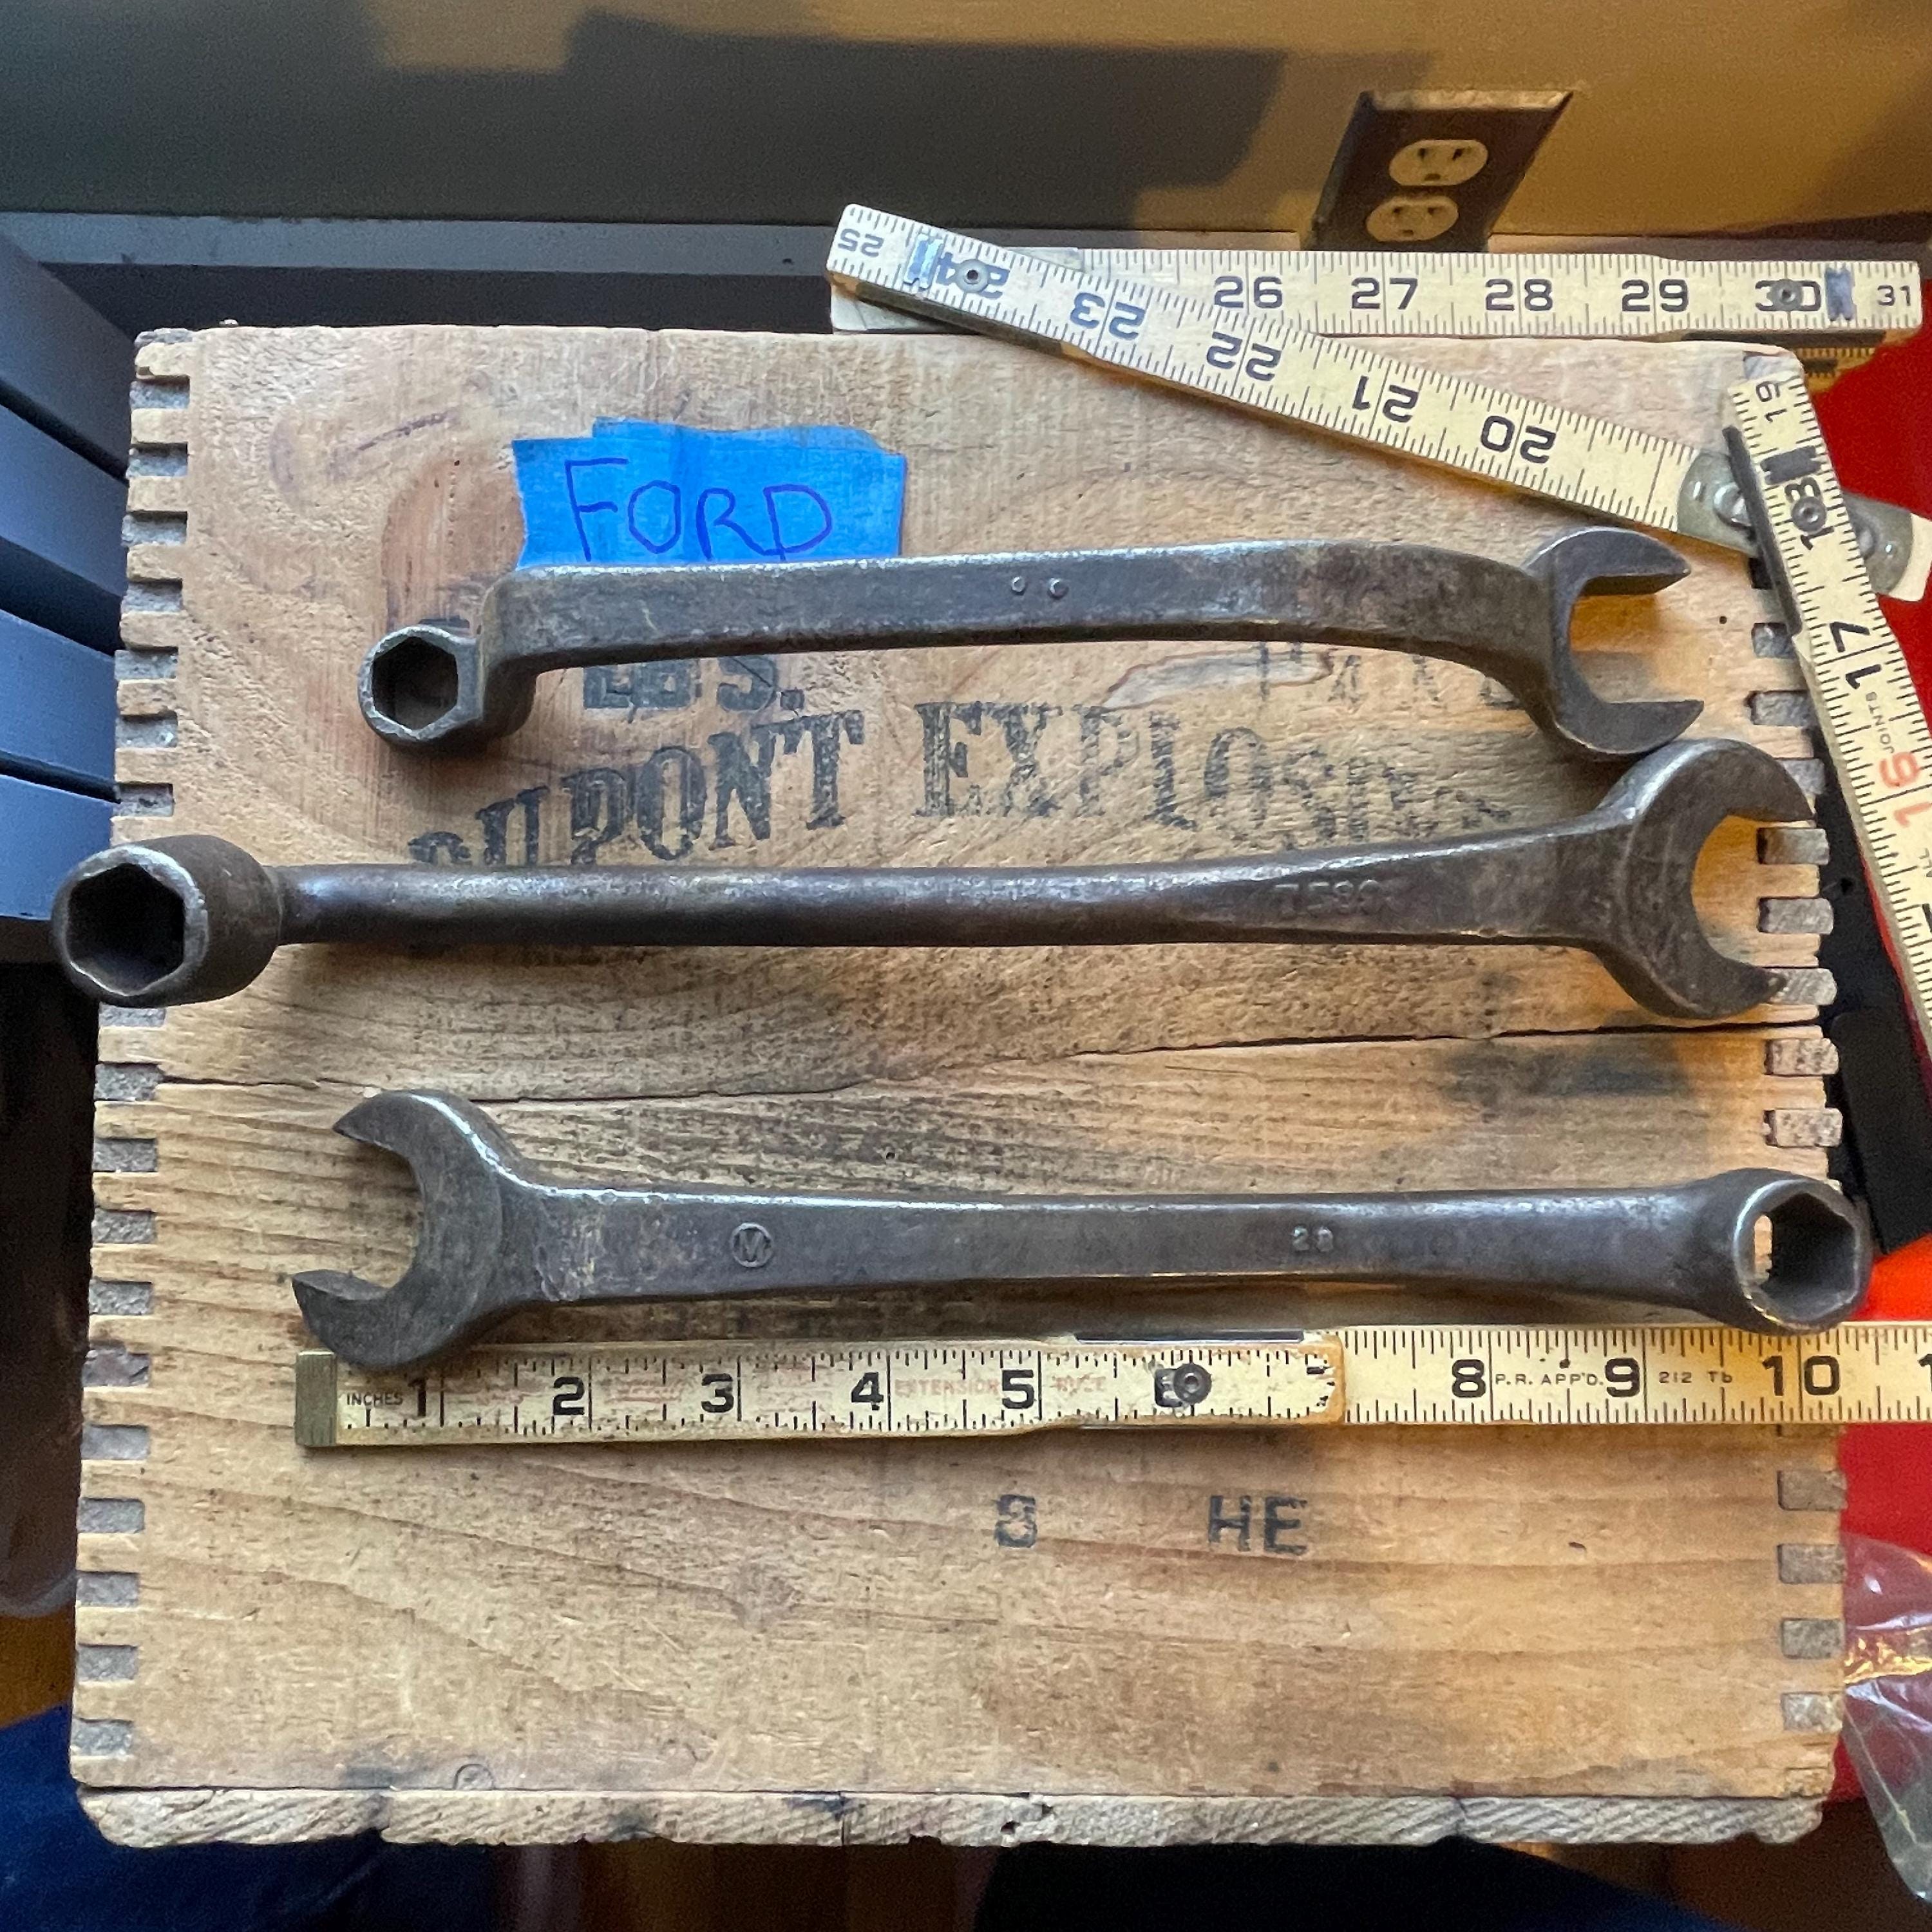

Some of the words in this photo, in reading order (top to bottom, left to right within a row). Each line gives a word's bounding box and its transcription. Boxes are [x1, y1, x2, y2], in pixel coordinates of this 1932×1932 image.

[838, 228, 884, 257] 25
[936, 252, 1010, 300] 24
[1214, 275, 1283, 310] 26
[1350, 278, 1418, 310] 27
[1484, 278, 1553, 312] 28
[1621, 279, 1689, 312] 29
[1877, 285, 1912, 306] 31
[1070, 292, 1146, 341] 23
[1207, 331, 1283, 382] 22
[1352, 375, 1418, 423] 21
[1756, 381, 1787, 422] 19
[1481, 415, 1556, 464] 20
[565, 457, 832, 562] FORD
[1830, 621, 1882, 690] 17
[1866, 691, 1895, 753] JOINTS
[407, 709, 864, 866] UPONT
[1879, 751, 1932, 828] 16
[346, 1392, 403, 1406] INCHES
[407, 1377, 427, 1417] 1
[552, 1376, 585, 1416] 2
[701, 1372, 735, 1414] 3
[851, 1371, 884, 1411] 4
[1001, 1369, 1035, 1410] 5
[1451, 1358, 1486, 1399] 8
[1604, 1356, 1641, 1399] 9
[1761, 1354, 1842, 1399] 10
[1208, 1494, 1307, 1557] HE
